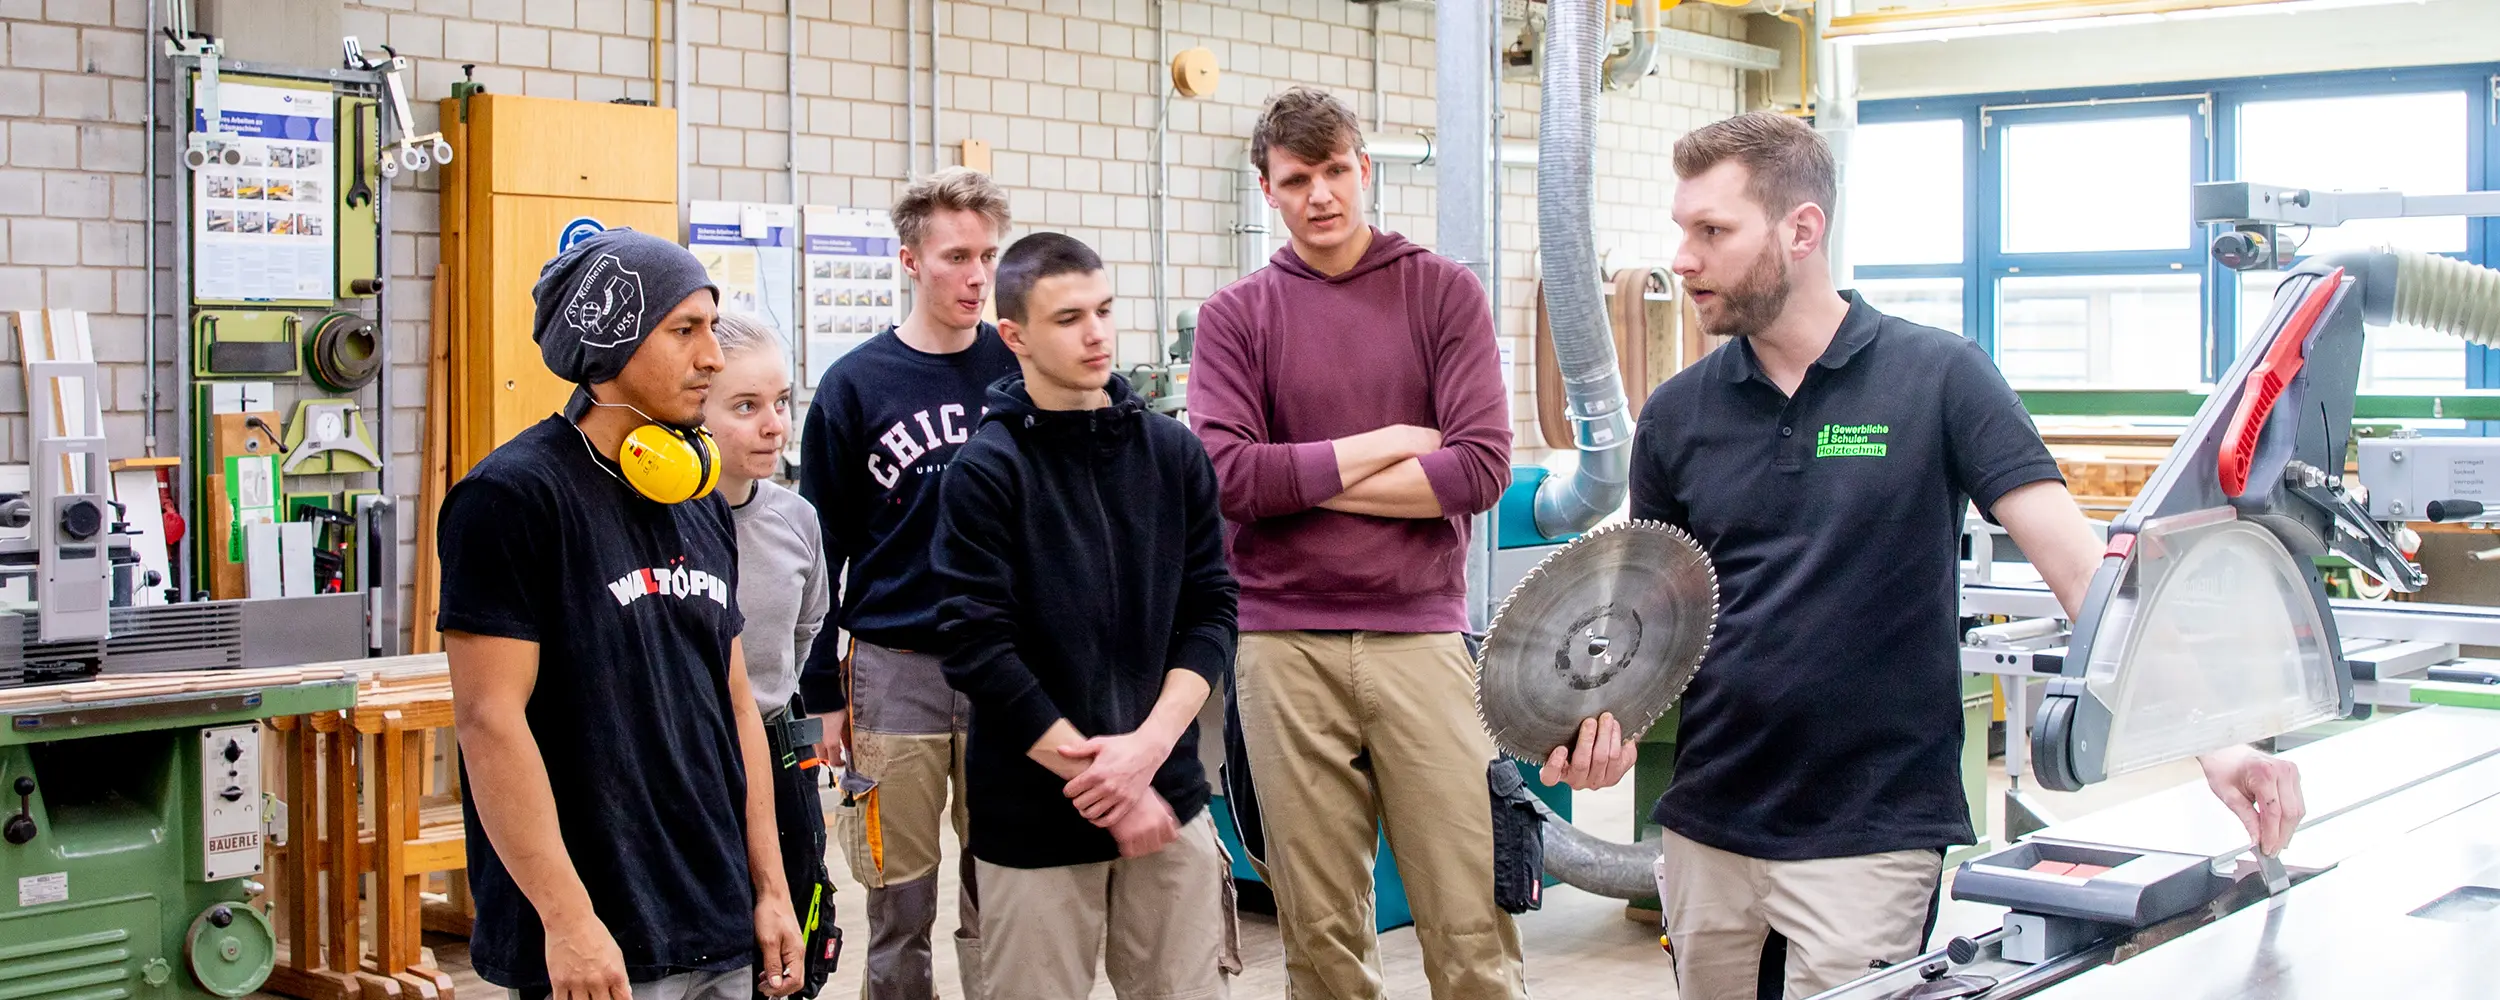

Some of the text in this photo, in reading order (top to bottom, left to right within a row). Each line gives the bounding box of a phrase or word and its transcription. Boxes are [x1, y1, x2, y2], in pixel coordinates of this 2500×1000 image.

[568, 300, 580, 317] SV
[613, 311, 636, 338] 1955
[1832, 424, 1889, 434] Gewerbliche
[1831, 434, 1868, 443] Schulen
[868, 403, 990, 489] CHIC
[1818, 445, 1884, 455] Holztechnik
